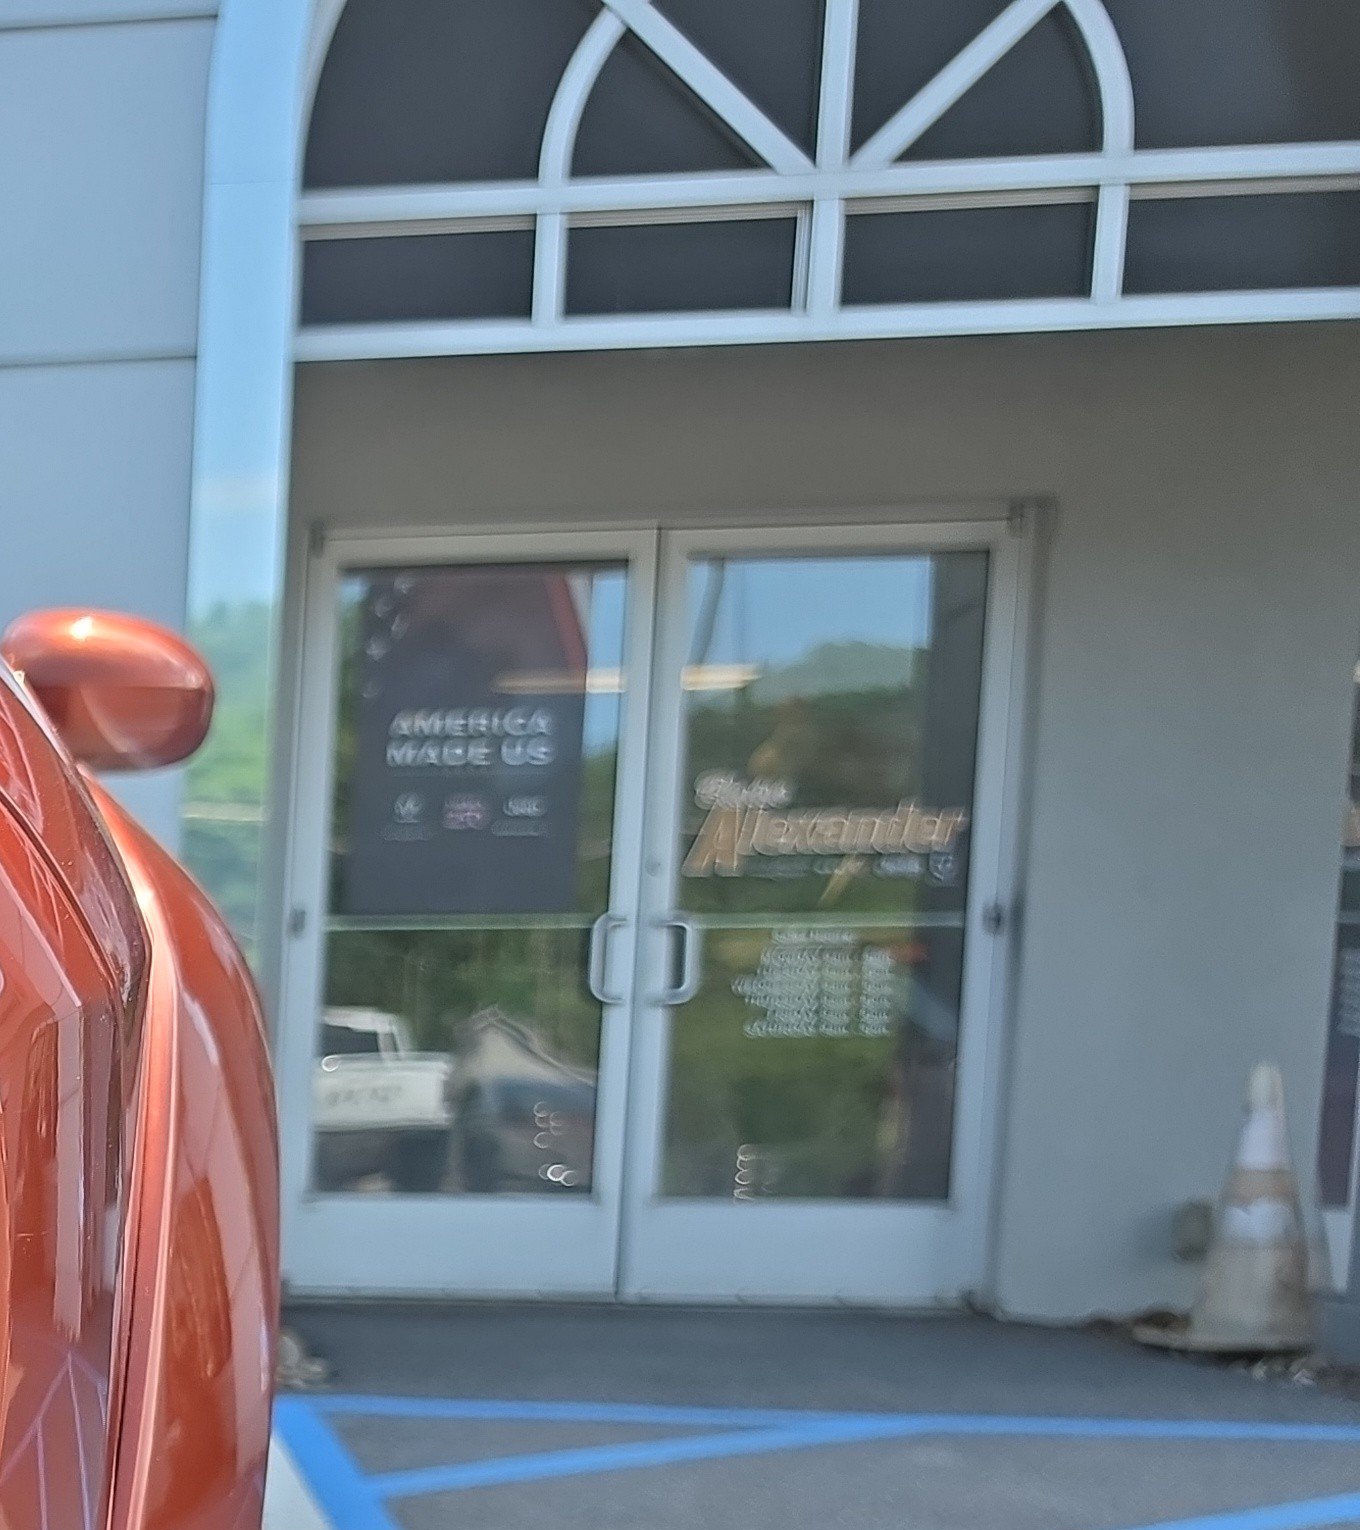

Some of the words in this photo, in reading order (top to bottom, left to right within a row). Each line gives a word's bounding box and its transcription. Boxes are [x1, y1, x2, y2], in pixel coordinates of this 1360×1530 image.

[389, 707, 553, 737] AMERICA
[386, 738, 492, 767] MADE
[501, 737, 555, 766] US
[682, 800, 966, 878] Alexander
